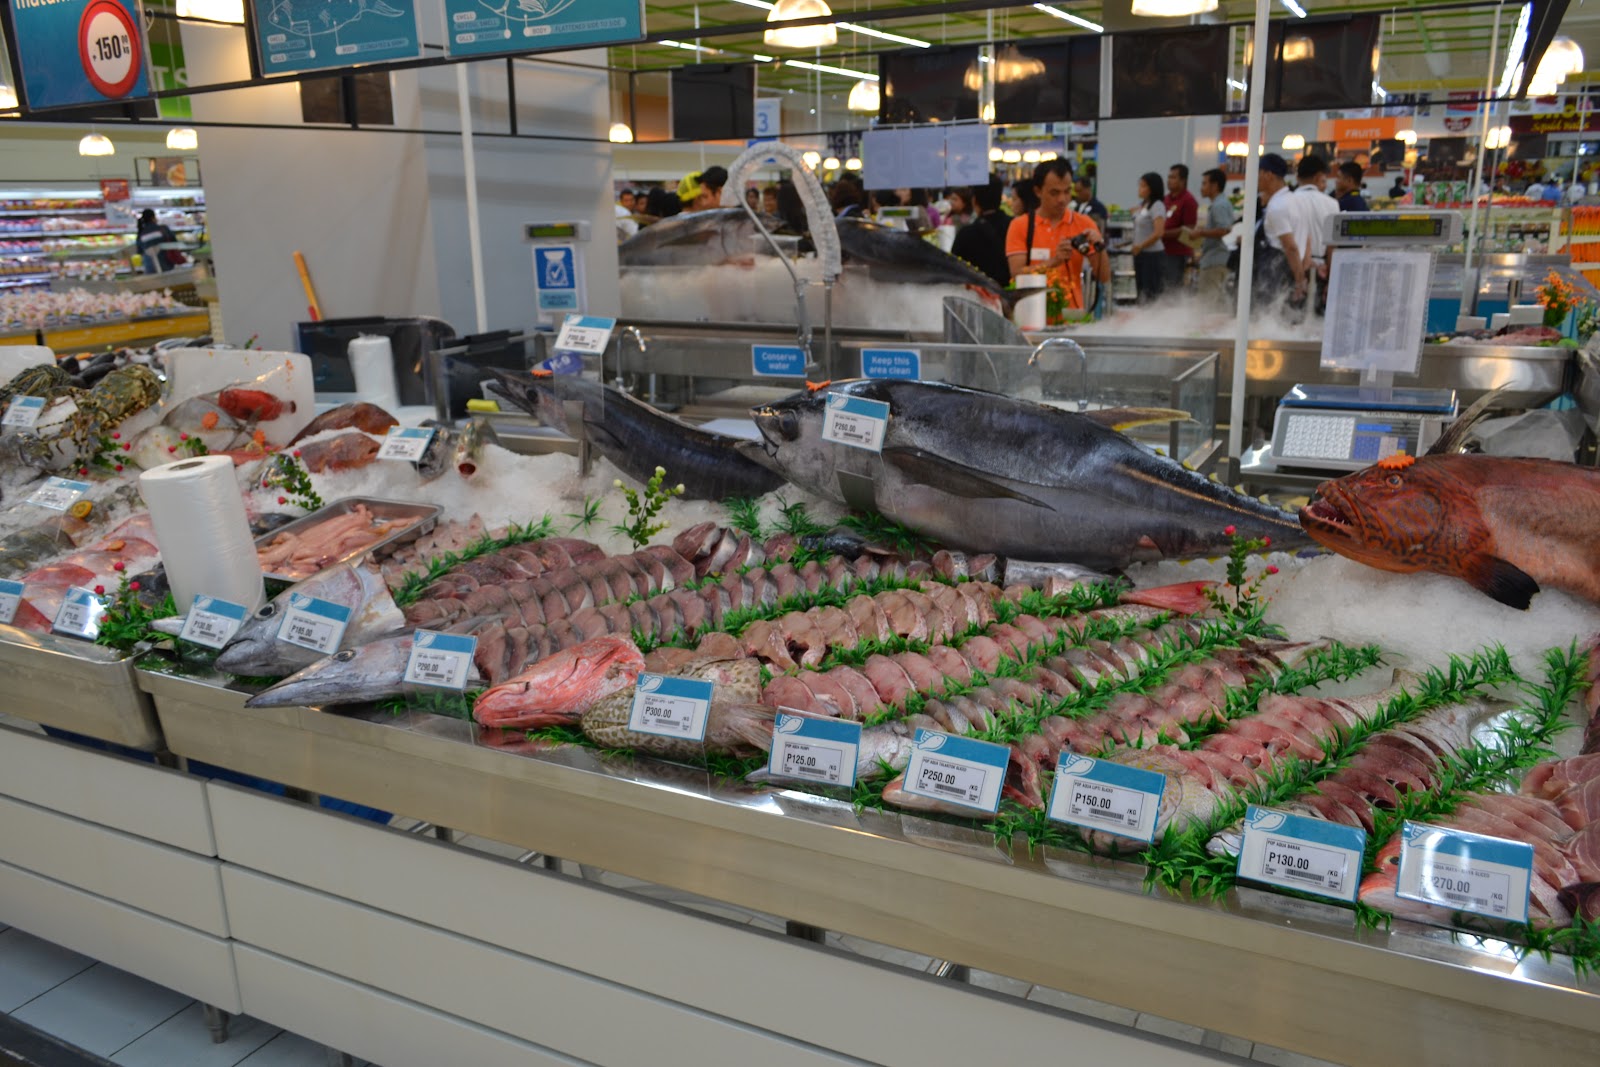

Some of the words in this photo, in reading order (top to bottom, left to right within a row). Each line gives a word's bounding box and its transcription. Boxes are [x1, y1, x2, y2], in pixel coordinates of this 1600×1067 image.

[757, 113, 769, 133] 3
[1345, 127, 1382, 139] FRUITS
[761, 351, 797, 361] Conserve
[871, 355, 894, 367] Keep
[894, 354, 910, 366] this
[768, 361, 790, 371] water
[869, 366, 887, 375] area
[888, 365, 911, 376] clean
[645, 706, 672, 718] P300.00
[786, 753, 817, 767] P125.00
[922, 769, 956, 785] P250.00
[969, 784, 979, 792] /KG
[1075, 792, 1112, 810] P150.00
[1126, 808, 1137, 816] /KG
[1268, 852, 1310, 870] P130.00
[1327, 869, 1339, 877] /KG
[1431, 875, 1471, 894] 270.00
[1490, 892, 1504, 901] /KG
